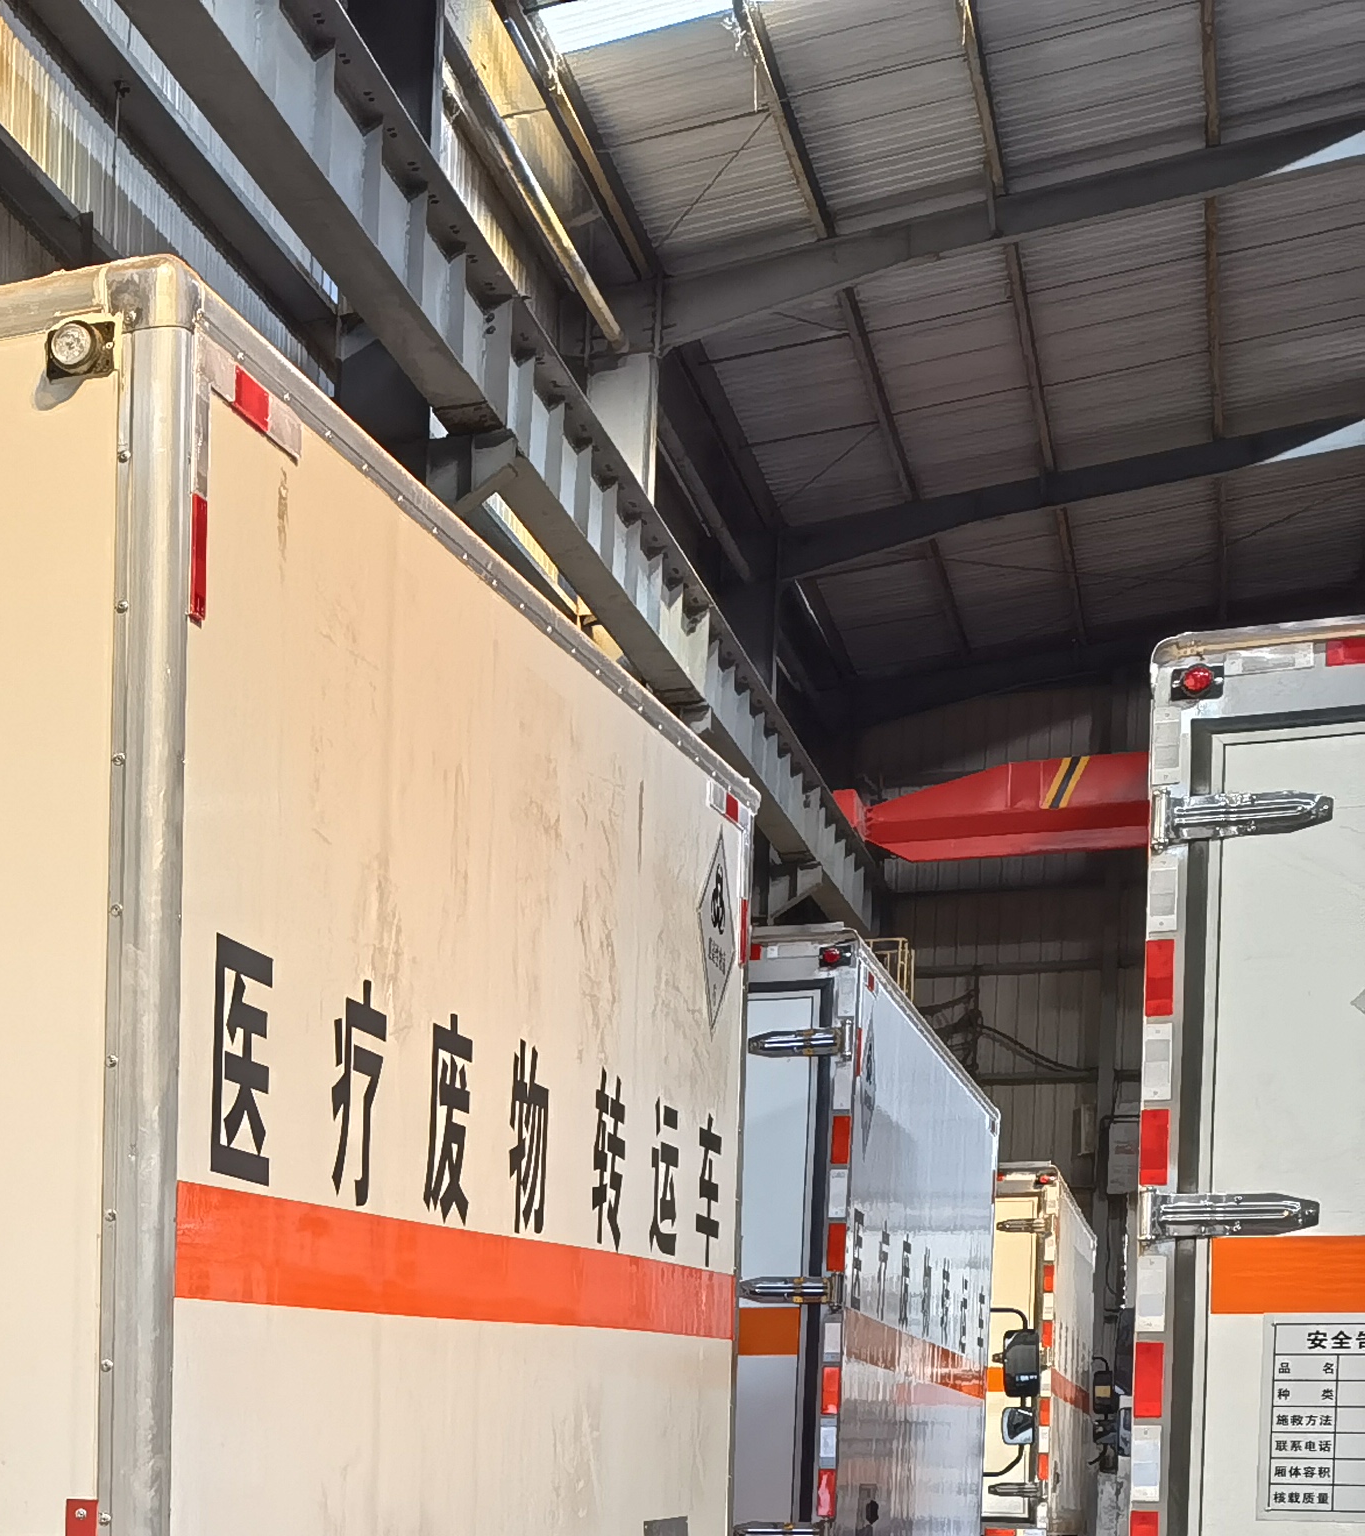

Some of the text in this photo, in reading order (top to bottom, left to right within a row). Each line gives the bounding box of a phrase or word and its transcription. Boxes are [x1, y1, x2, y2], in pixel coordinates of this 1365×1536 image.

[210, 931, 723, 1268] 医疗废物转运车
[1278, 1361, 1335, 1375] 品 名
[1277, 1387, 1334, 1401] 种 类
[1275, 1413, 1333, 1427] 施救方法
[1274, 1439, 1333, 1453] 联系电话
[1274, 1465, 1331, 1479] 厢体容积
[1272, 1491, 1329, 1505] 核载质量
